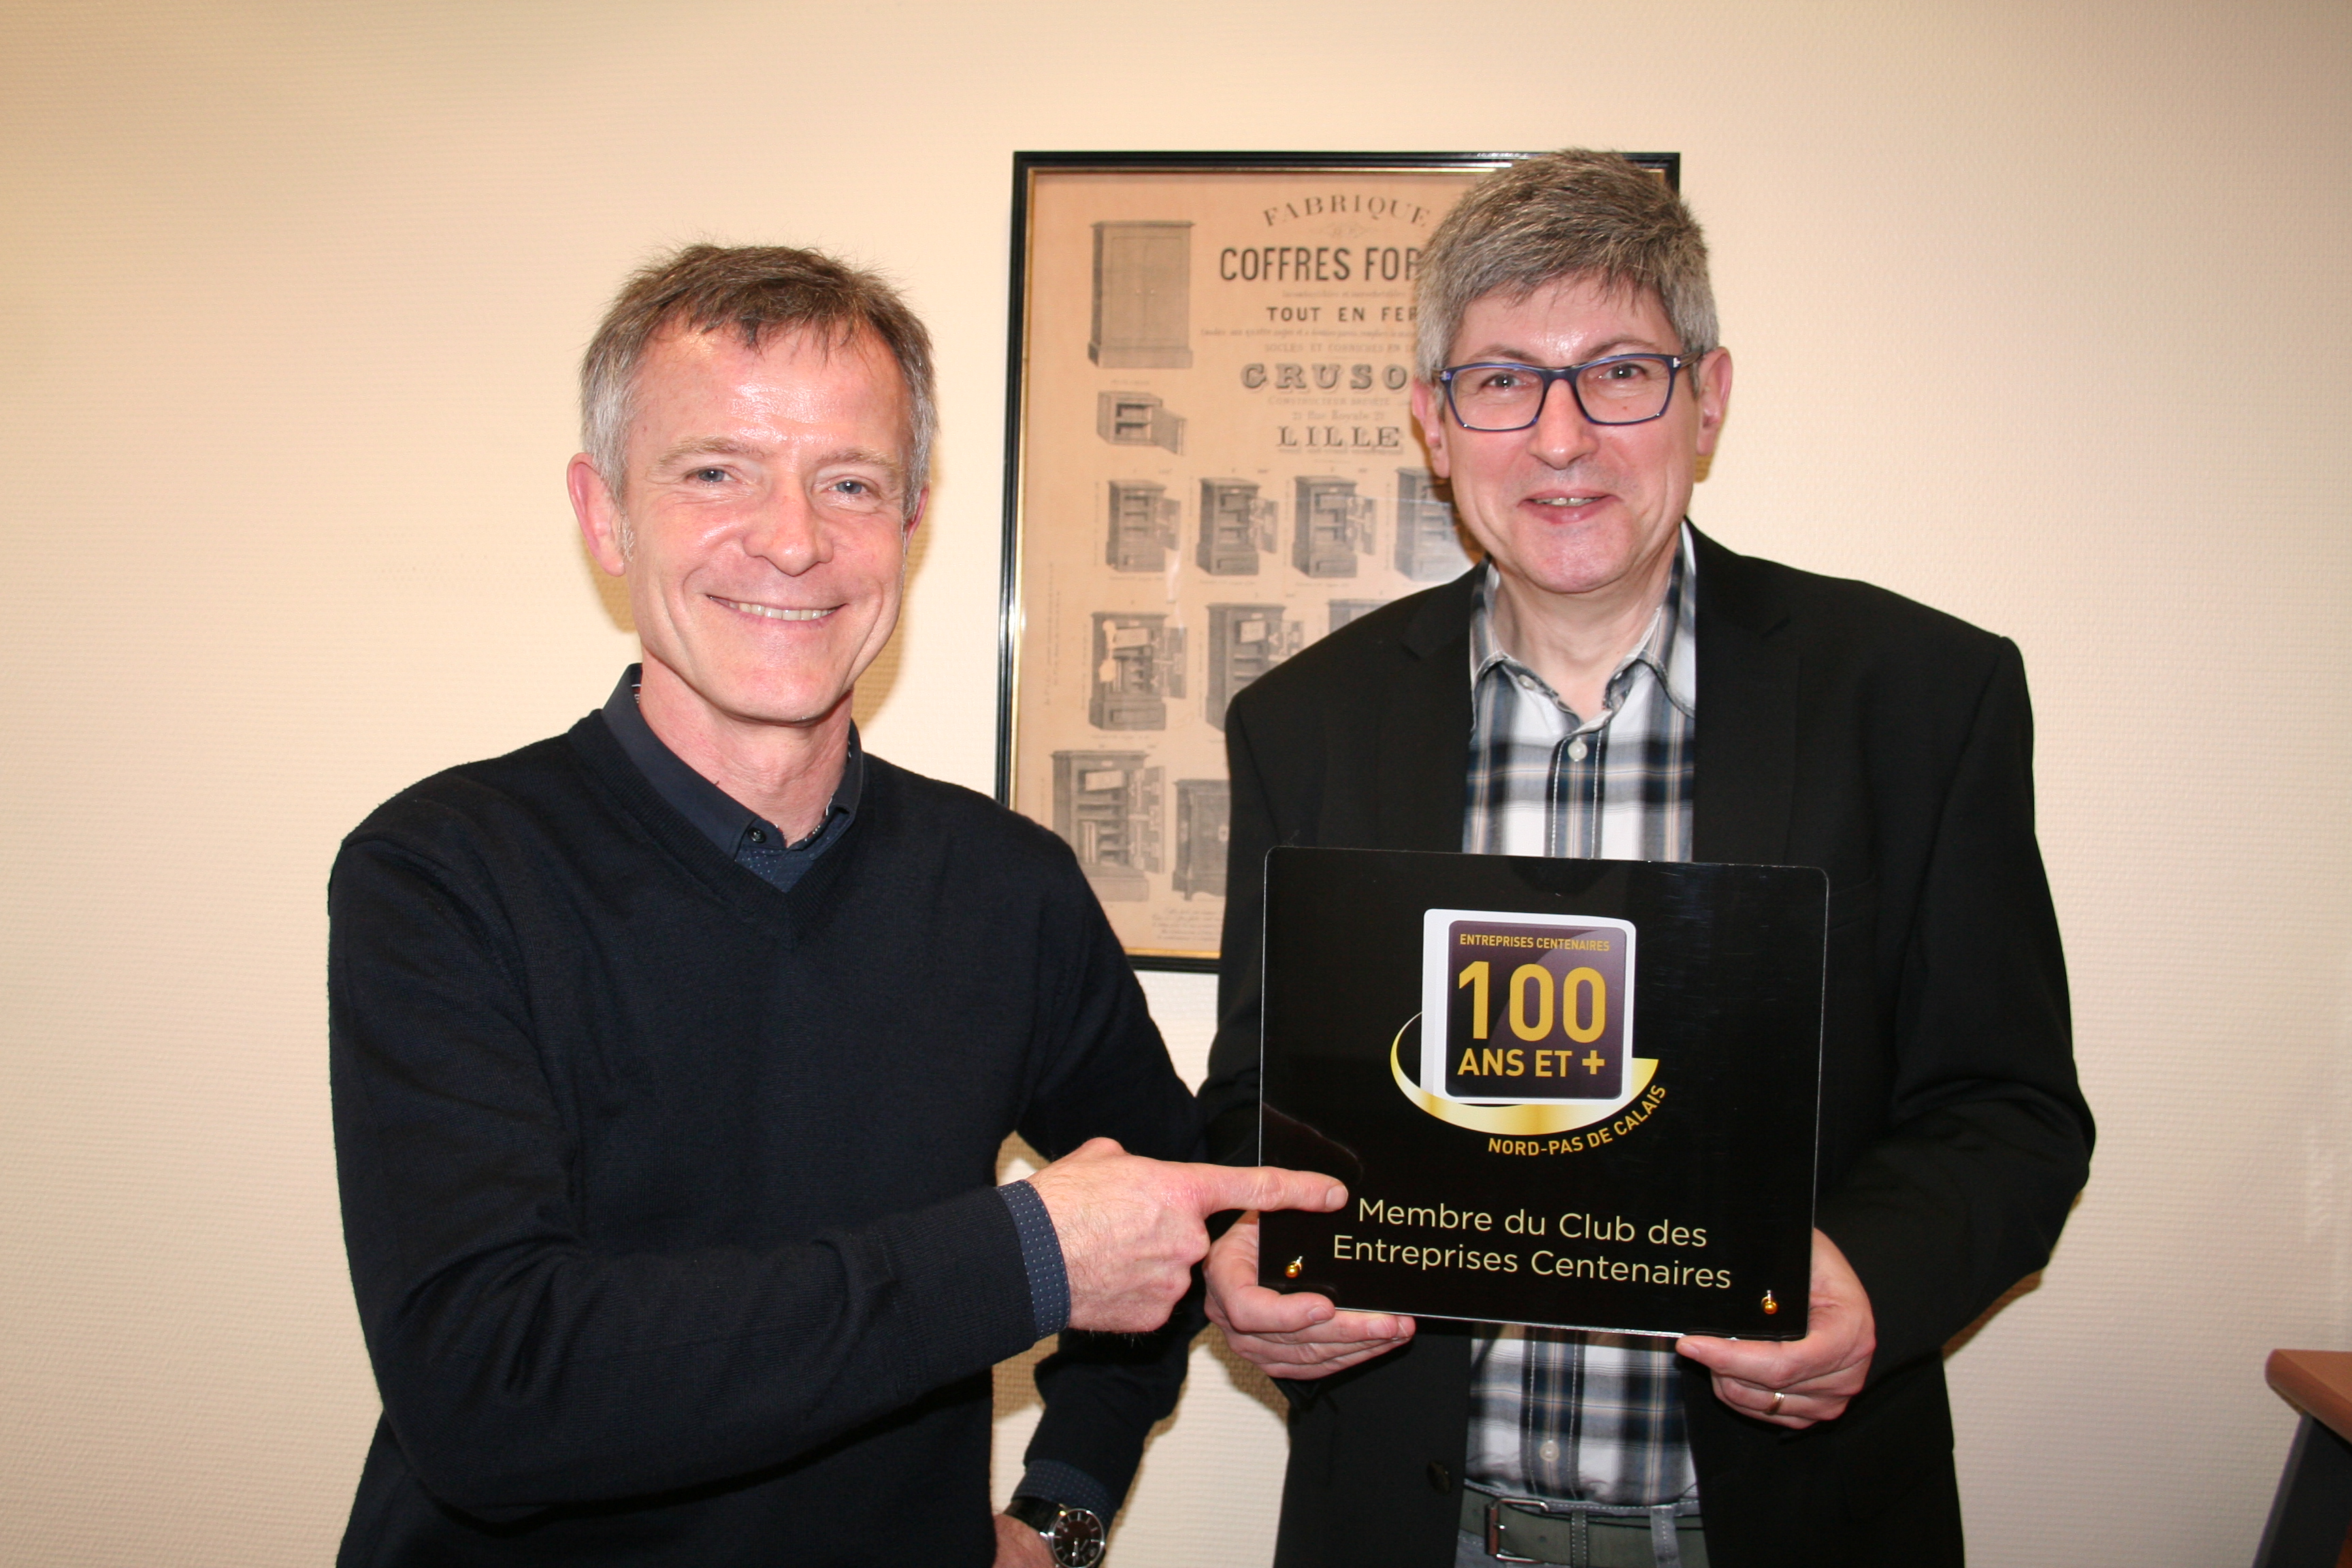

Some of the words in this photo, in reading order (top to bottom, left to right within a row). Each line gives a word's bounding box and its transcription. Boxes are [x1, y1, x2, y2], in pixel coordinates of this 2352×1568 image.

[1263, 195, 1429, 227] FABRIQUE
[1220, 247, 1351, 281] COFFRES
[1267, 307, 1321, 322] TOUT
[1339, 307, 1365, 322] EN
[1277, 426, 1402, 451] LILLE
[1459, 933, 1535, 949] ENTREPRISES
[1535, 937, 1610, 951] CENTENAIRES
[1458, 960, 1607, 1043] 100
[1457, 1048, 1525, 1077] ANS
[1535, 1050, 1573, 1077] ET
[1582, 1050, 1605, 1075] +
[1488, 1137, 1584, 1156] NORD-PAS
[1586, 1128, 1613, 1147] DE
[1614, 1085, 1666, 1136] CALAIS
[1359, 1198, 1492, 1231] Membre
[1505, 1209, 1545, 1235] du
[1559, 1213, 1635, 1242] Club
[1648, 1219, 1707, 1247] des
[1334, 1235, 1518, 1273] Entreprises
[1531, 1251, 1731, 1288] Centenaires
